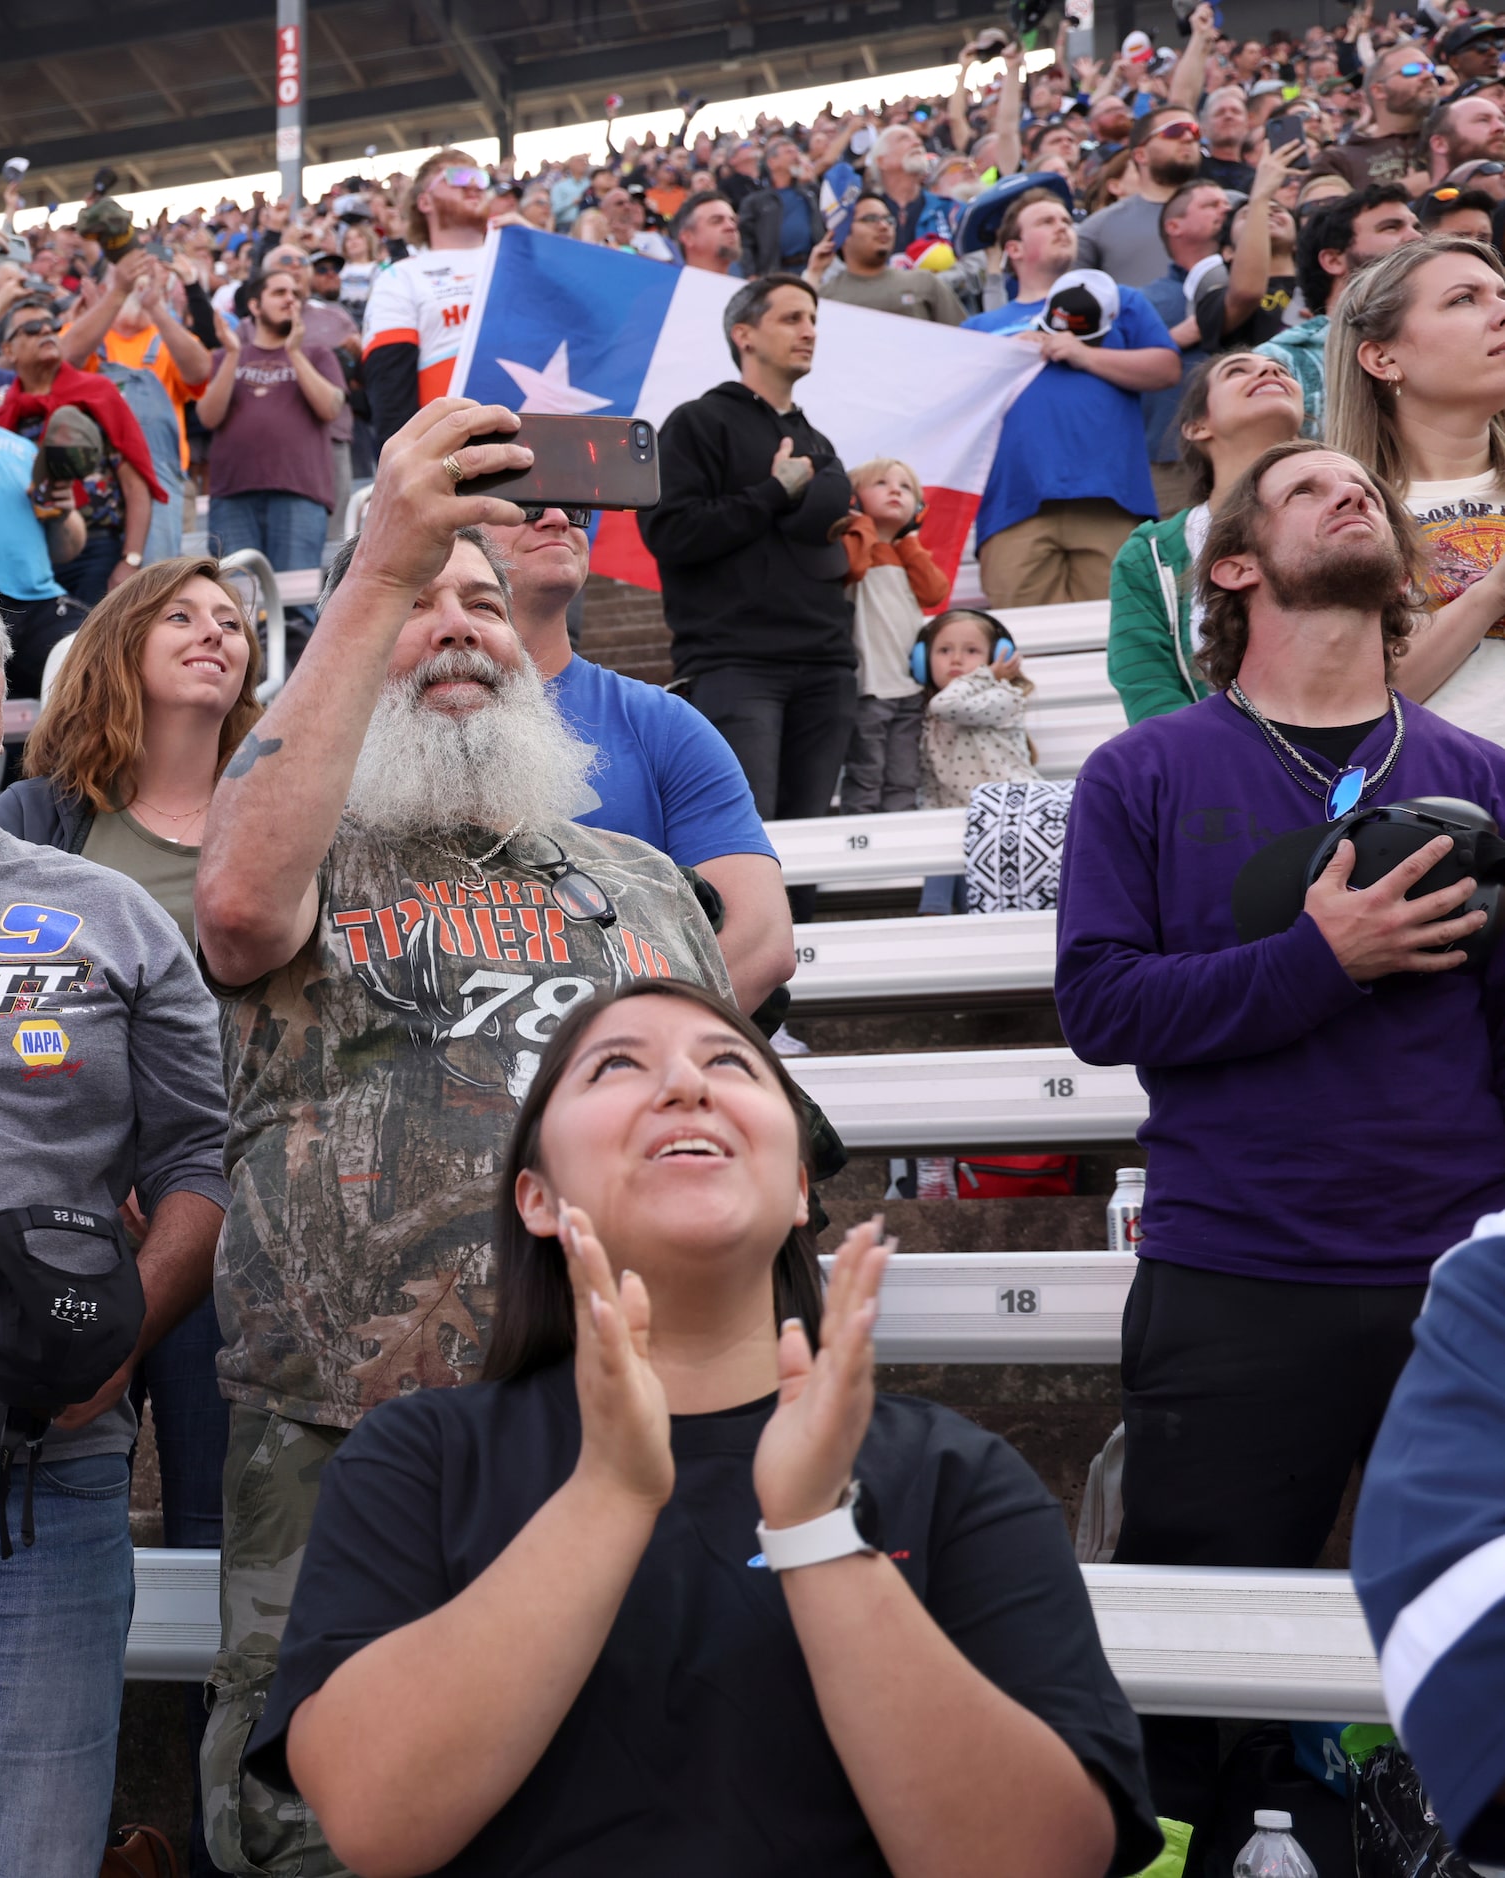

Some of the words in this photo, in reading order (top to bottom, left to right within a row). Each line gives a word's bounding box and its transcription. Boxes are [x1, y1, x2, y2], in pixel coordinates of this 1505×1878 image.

[278, 26, 299, 103] 120
[847, 835, 869, 849] 19
[333, 897, 573, 965] TRUEX
[795, 947, 816, 963] 19
[448, 968, 596, 1043] 78
[22, 1031, 63, 1054] NAPA
[1043, 1078, 1074, 1097] 18
[53, 1210, 70, 1222] 22
[72, 1213, 96, 1228] MAY
[1000, 1289, 1036, 1313] 18
